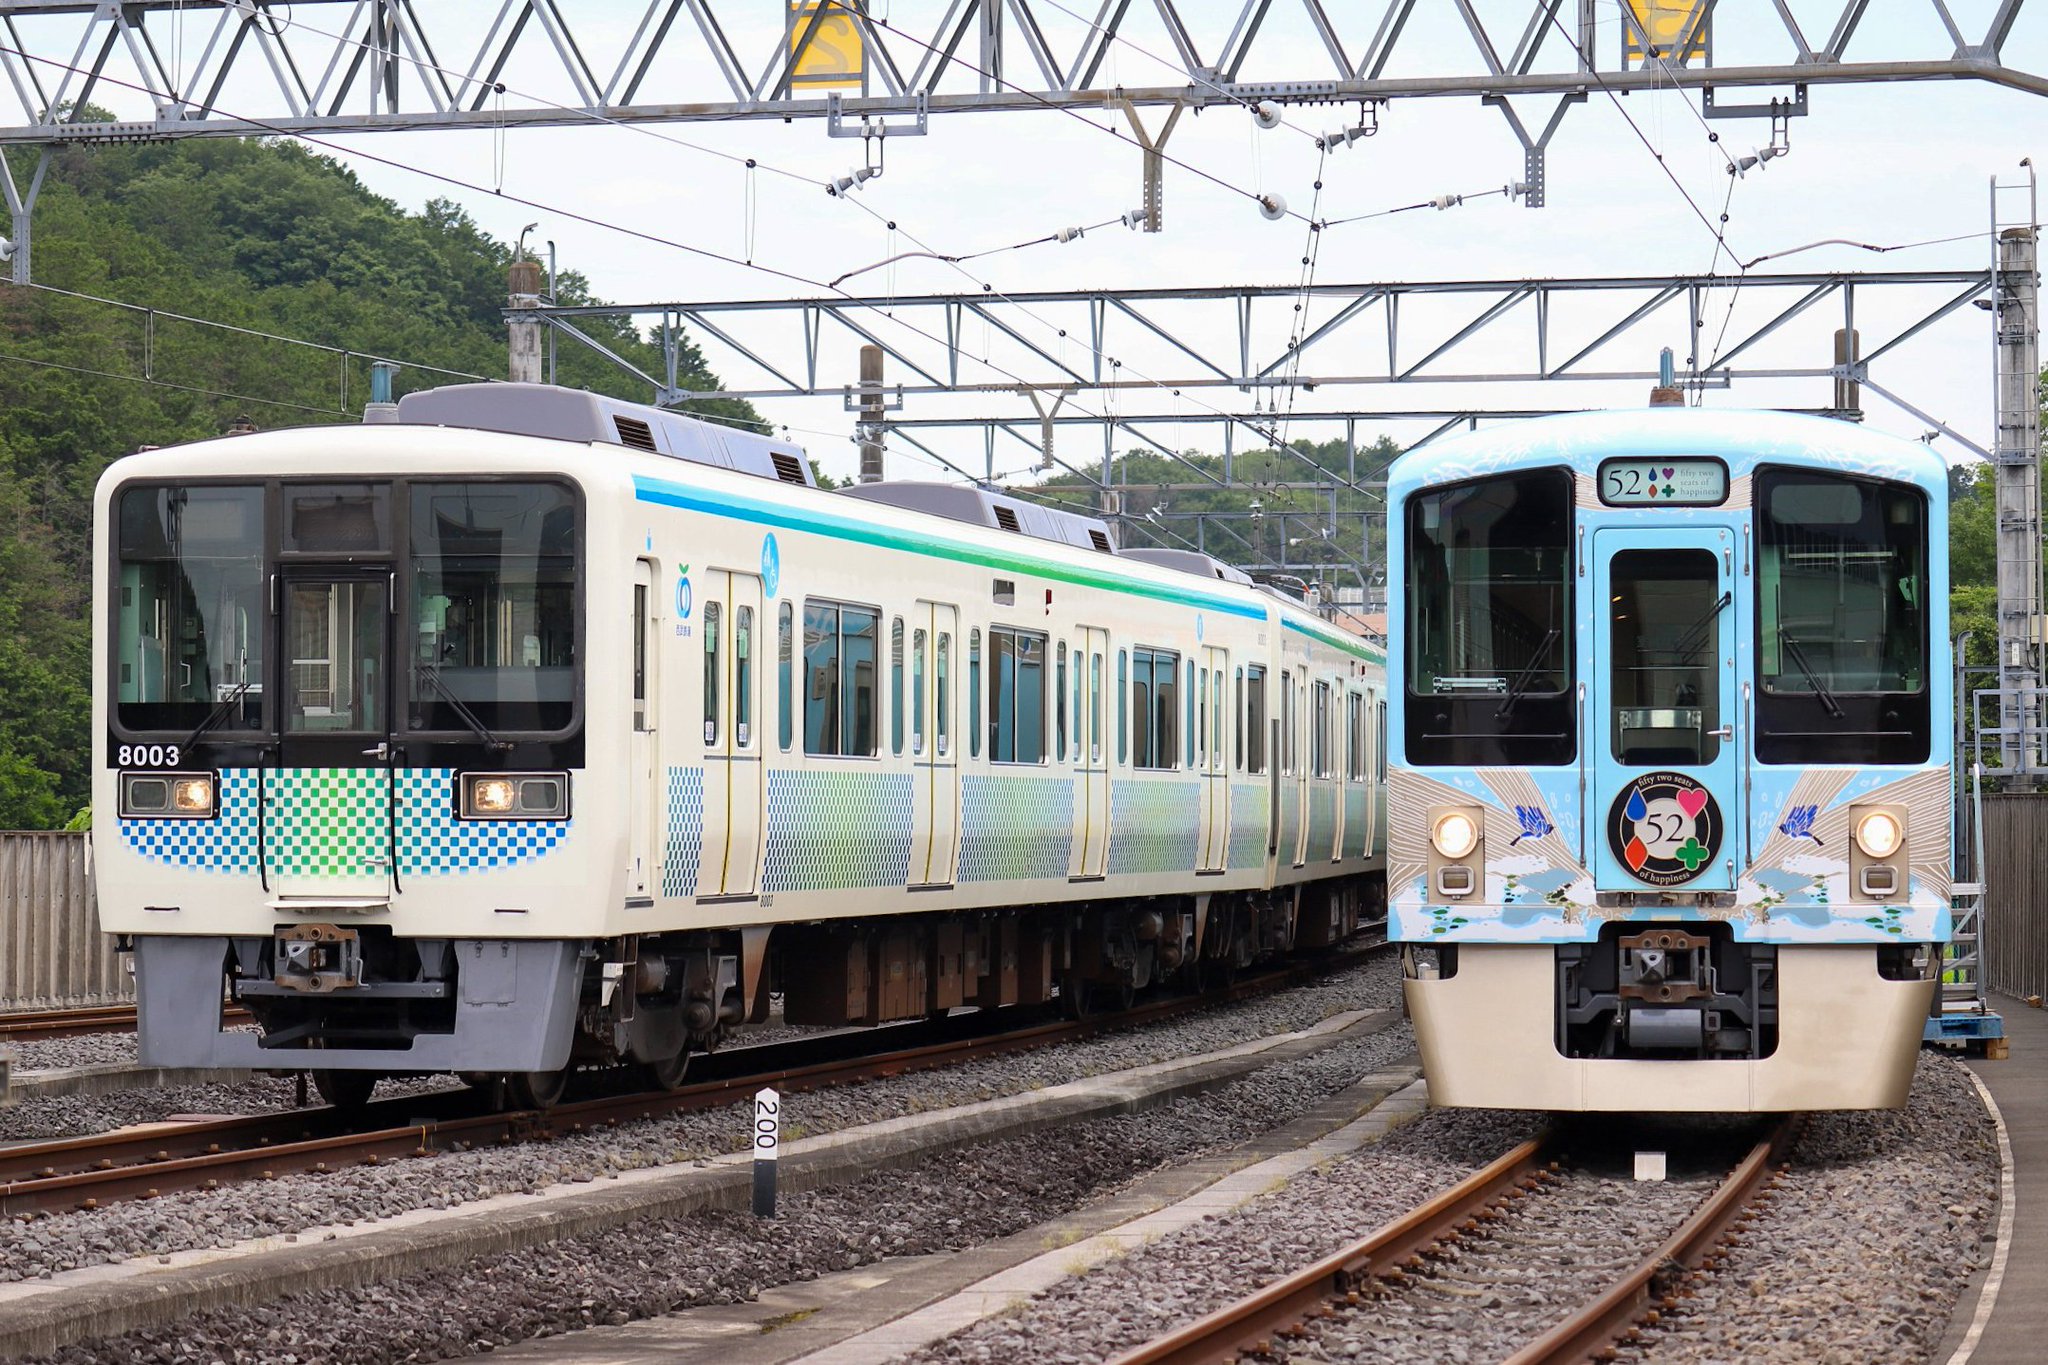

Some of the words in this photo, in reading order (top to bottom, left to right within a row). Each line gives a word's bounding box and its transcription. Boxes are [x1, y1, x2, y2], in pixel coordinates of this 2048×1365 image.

[1680, 469, 1696, 477] fifty
[1608, 469, 1641, 498] 52
[1680, 487, 1719, 497] happiness
[118, 745, 180, 767] 8003
[1638, 775, 1655, 787] fifty
[1657, 774, 1672, 782] two
[1674, 775, 1693, 788] seats
[1646, 813, 1685, 845] 52
[1639, 871, 1649, 879] of
[1650, 872, 1690, 885] happiness
[756, 1100, 778, 1148] 200
